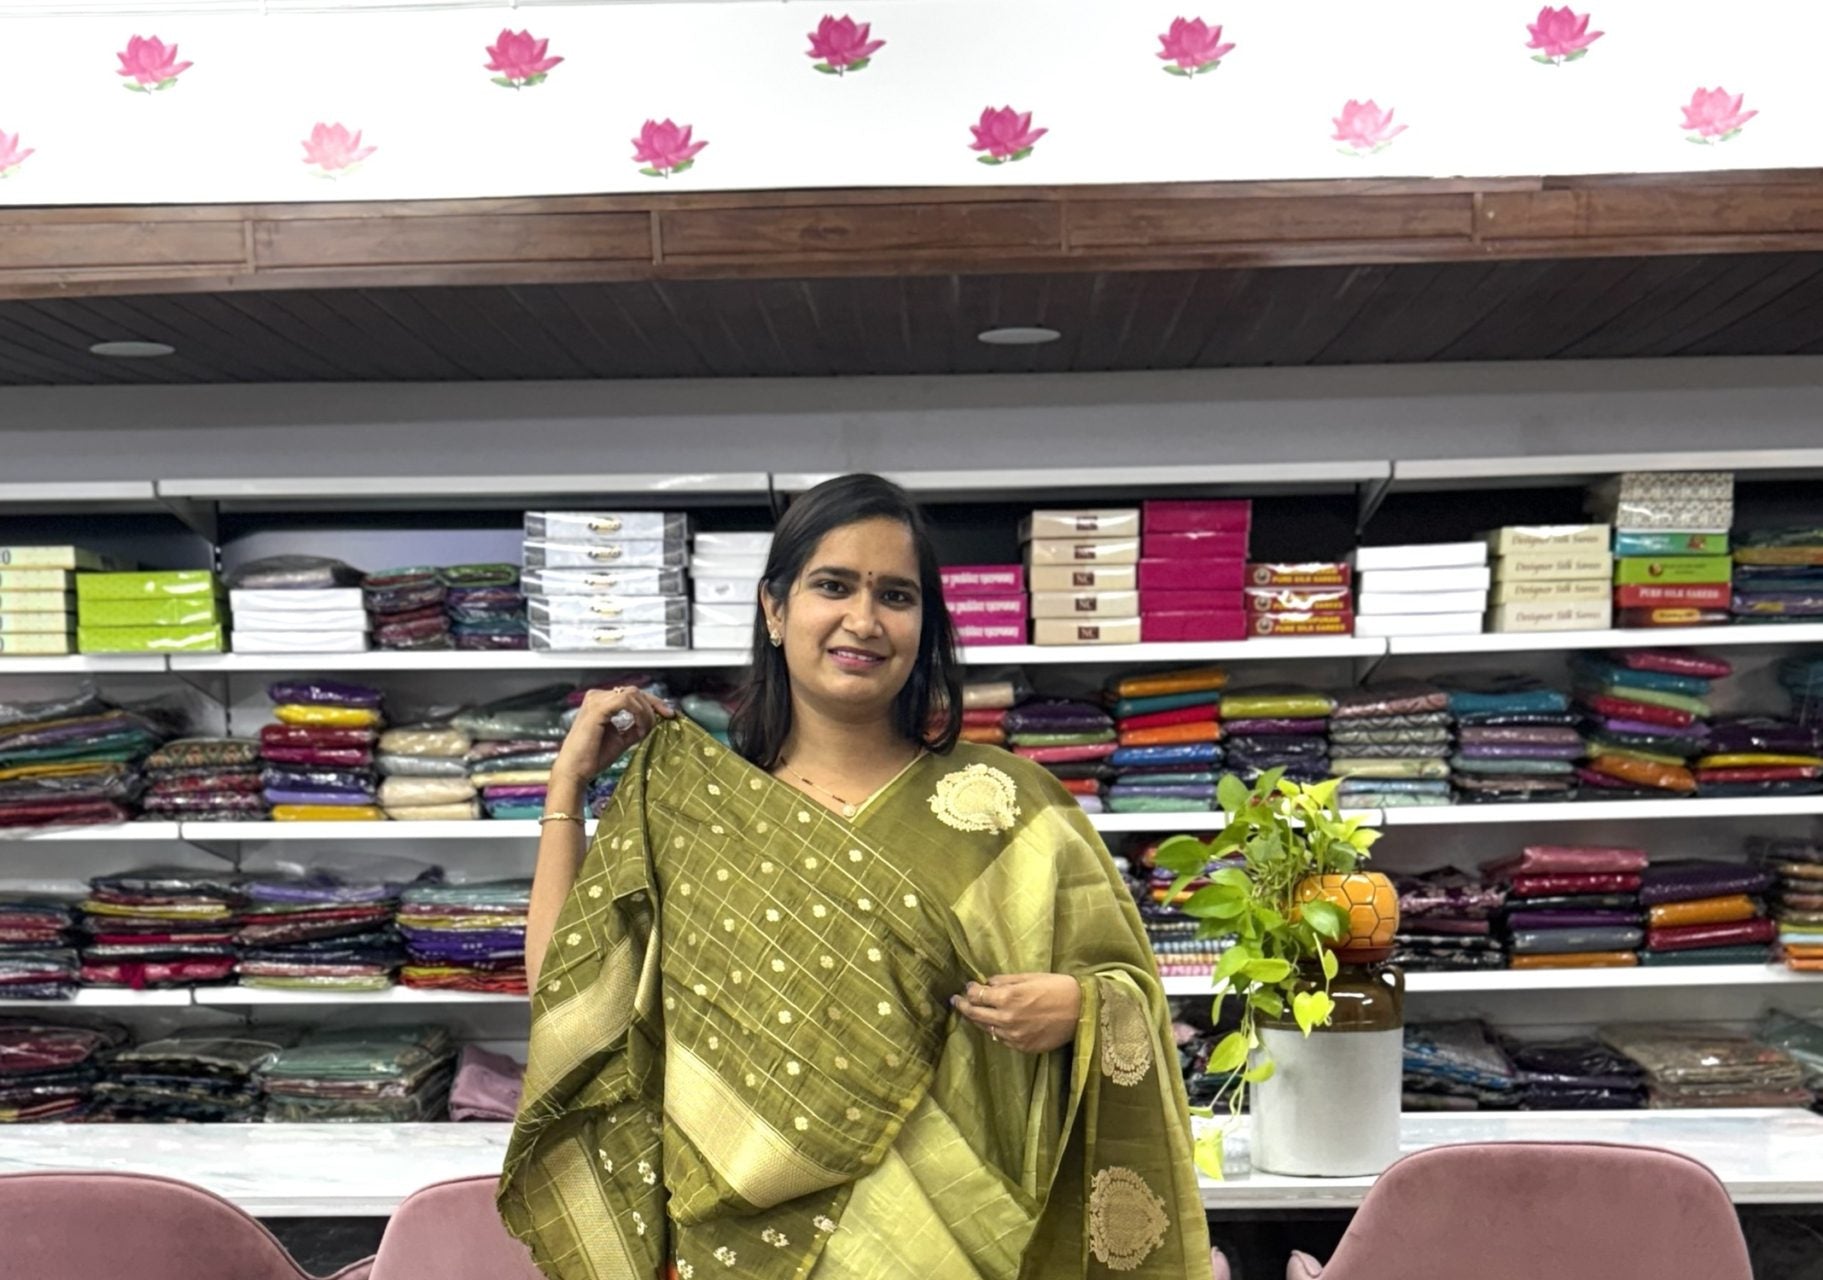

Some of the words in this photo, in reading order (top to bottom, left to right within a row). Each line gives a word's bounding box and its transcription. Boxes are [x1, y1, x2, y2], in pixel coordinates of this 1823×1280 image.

[1515, 562, 1553, 575] Designer
[1556, 560, 1572, 570] Silk
[1272, 575, 1292, 583] PURE
[1294, 575, 1311, 583] SILK
[1515, 585, 1552, 598] Designer
[1555, 583, 1571, 593] Silk
[1639, 588, 1662, 598] PURE
[1664, 588, 1684, 598] SILK
[1686, 588, 1720, 599] SAREES
[1516, 611, 1553, 625] Designer
[1556, 610, 1573, 620] Silk
[1297, 624, 1314, 632] SILK
